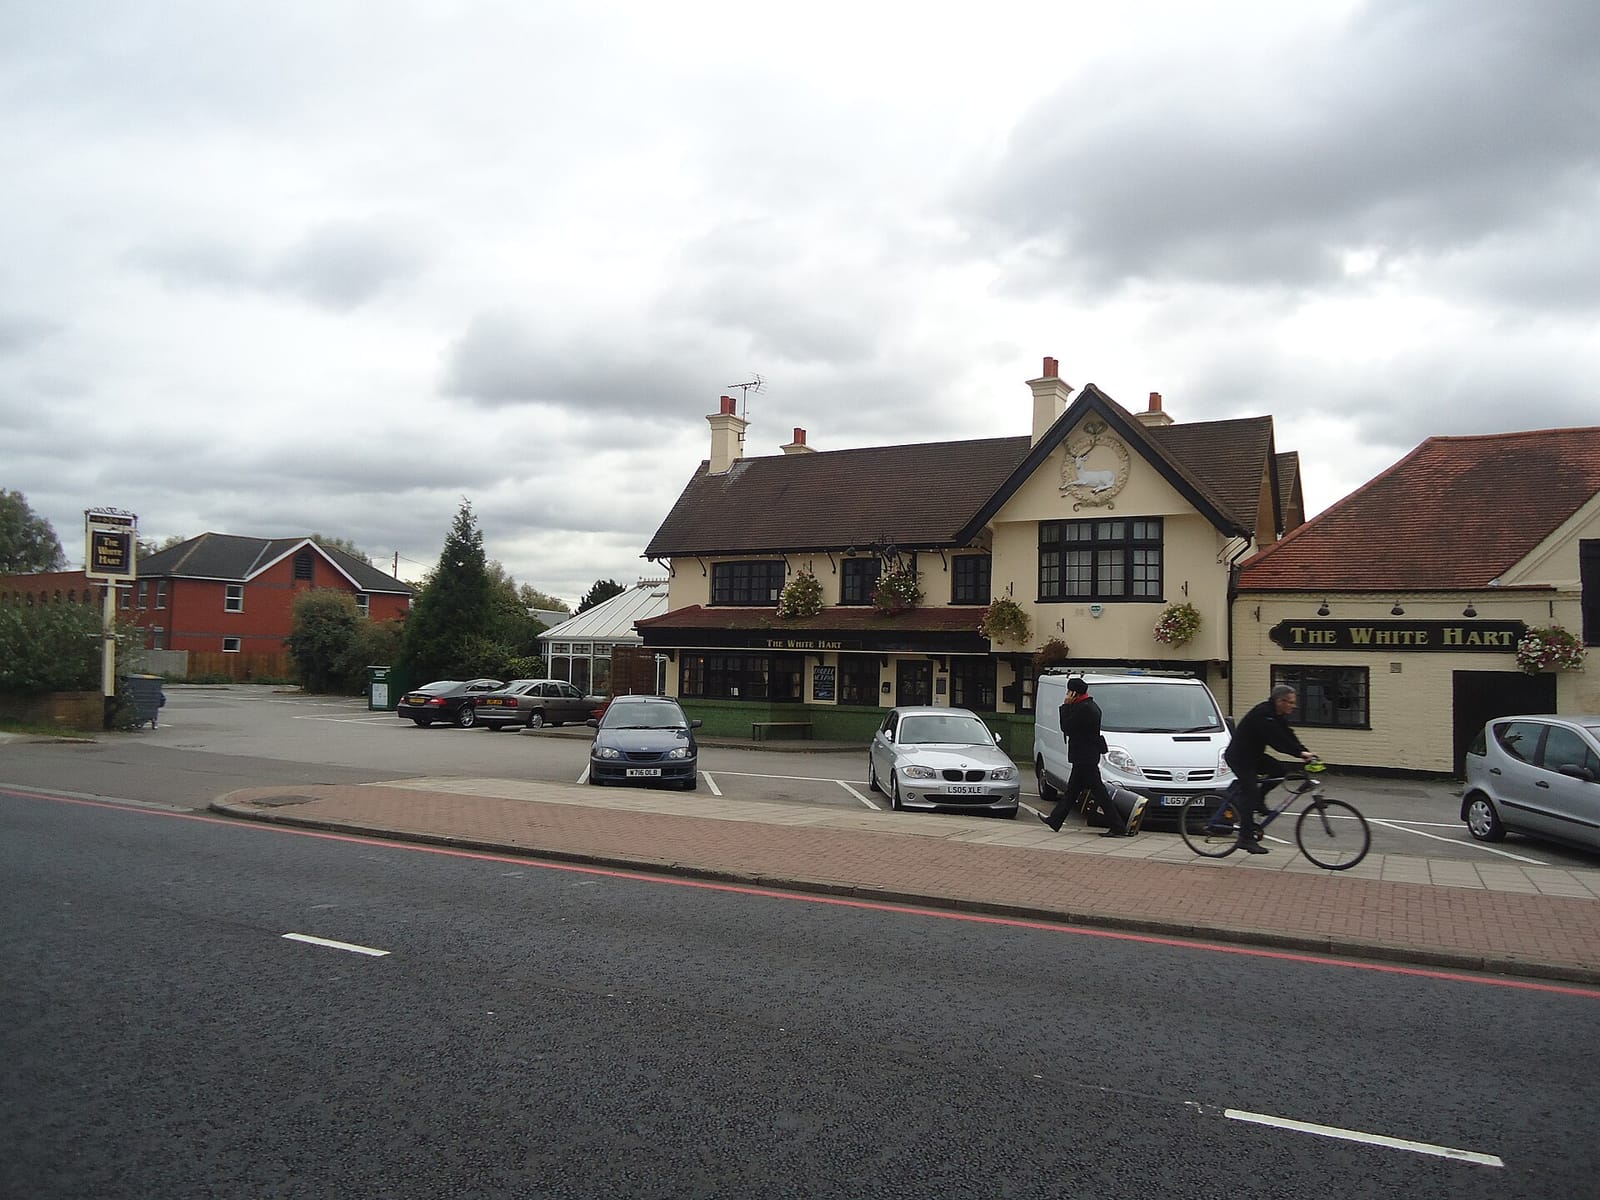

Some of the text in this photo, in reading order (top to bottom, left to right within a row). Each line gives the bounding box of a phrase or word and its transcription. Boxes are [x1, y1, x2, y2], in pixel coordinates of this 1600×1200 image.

[1290, 627, 1514, 646] THE WHITE HART
[767, 639, 842, 649] THE WHITE HART
[1165, 797, 1186, 805] LG57
